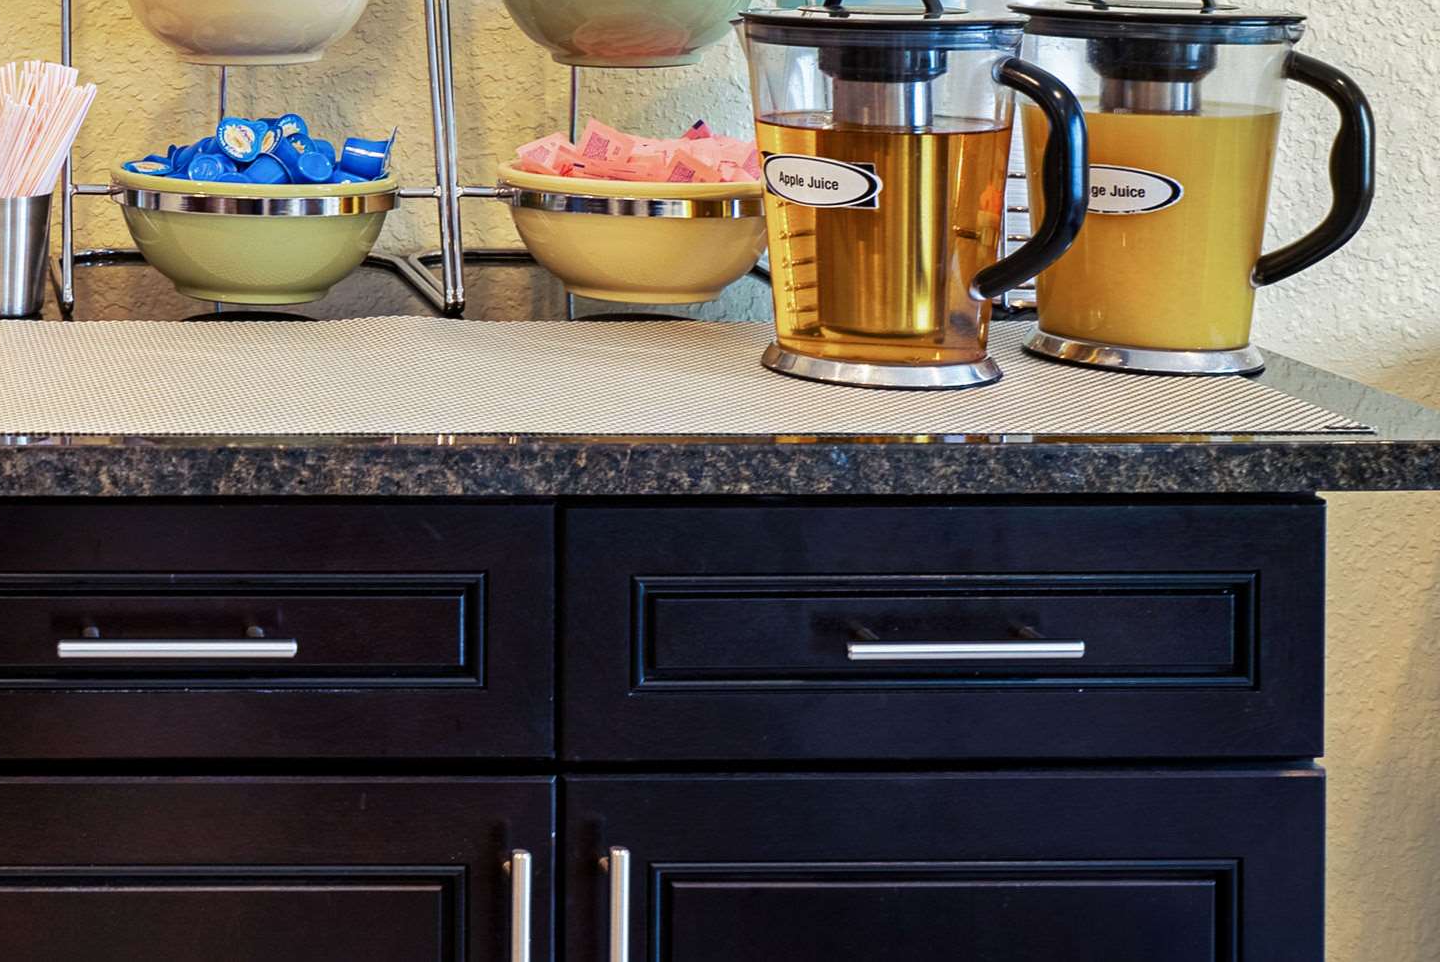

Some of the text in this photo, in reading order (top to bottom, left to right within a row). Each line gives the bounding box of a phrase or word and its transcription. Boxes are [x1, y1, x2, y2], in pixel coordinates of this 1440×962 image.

[778, 170, 839, 191] Apple Juice
[1109, 184, 1146, 198] Juice
